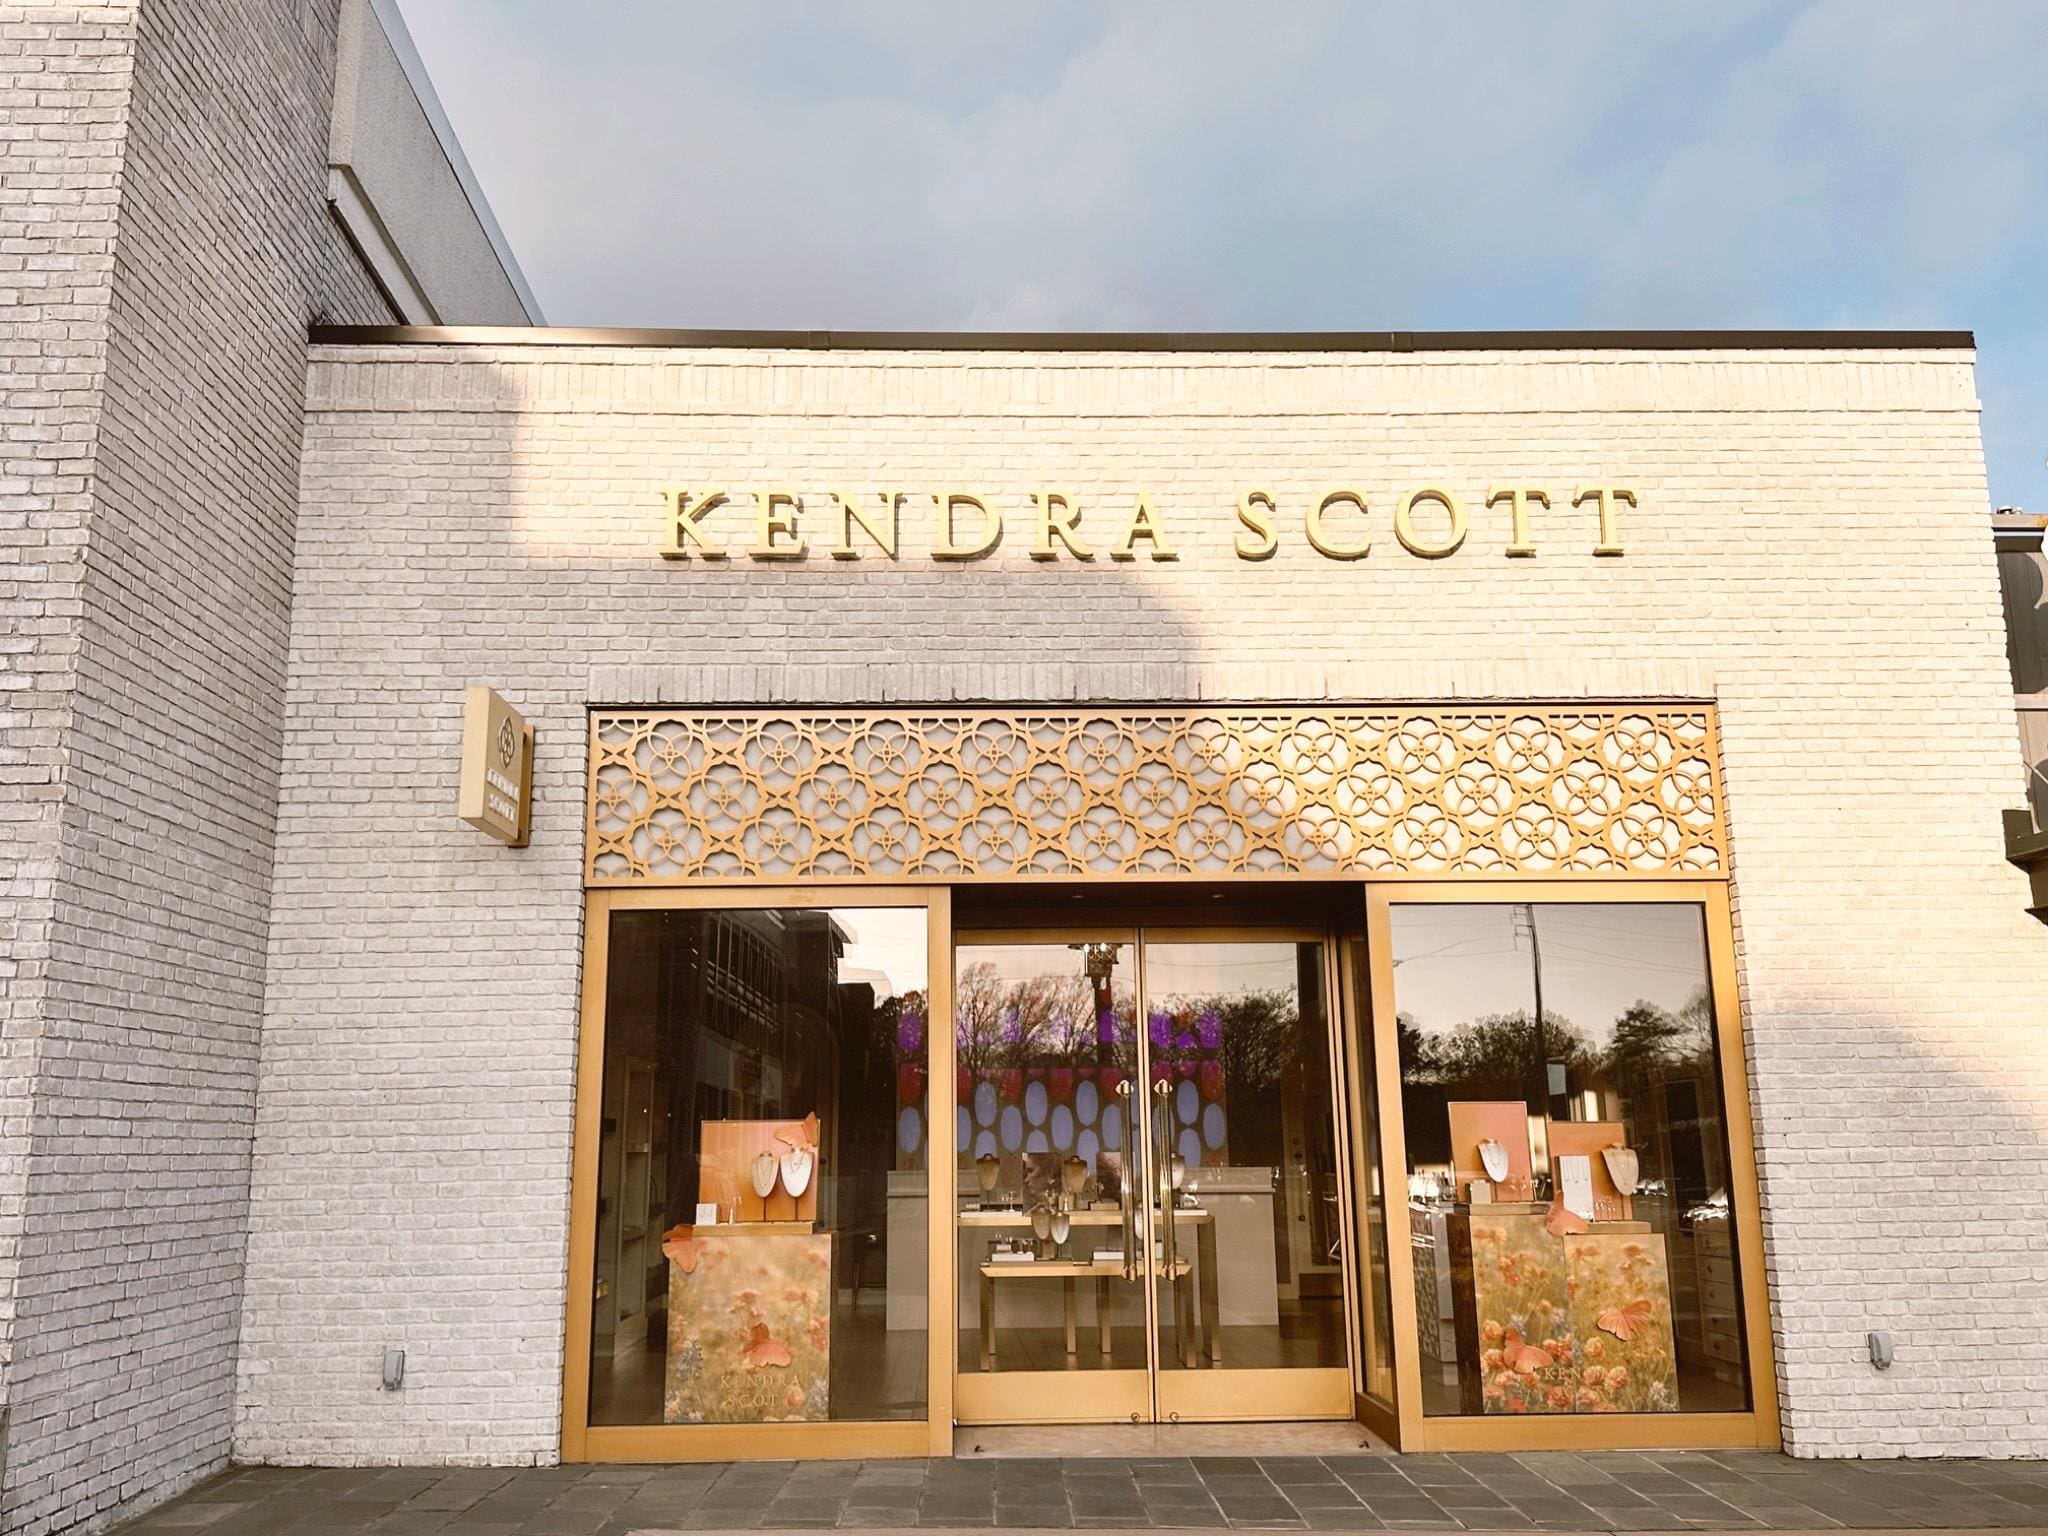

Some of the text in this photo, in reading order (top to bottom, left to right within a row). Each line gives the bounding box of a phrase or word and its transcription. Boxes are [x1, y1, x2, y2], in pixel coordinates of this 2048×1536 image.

[660, 487, 1637, 561] KENDRA SCOTT
[728, 1393, 788, 1408] SCOT
